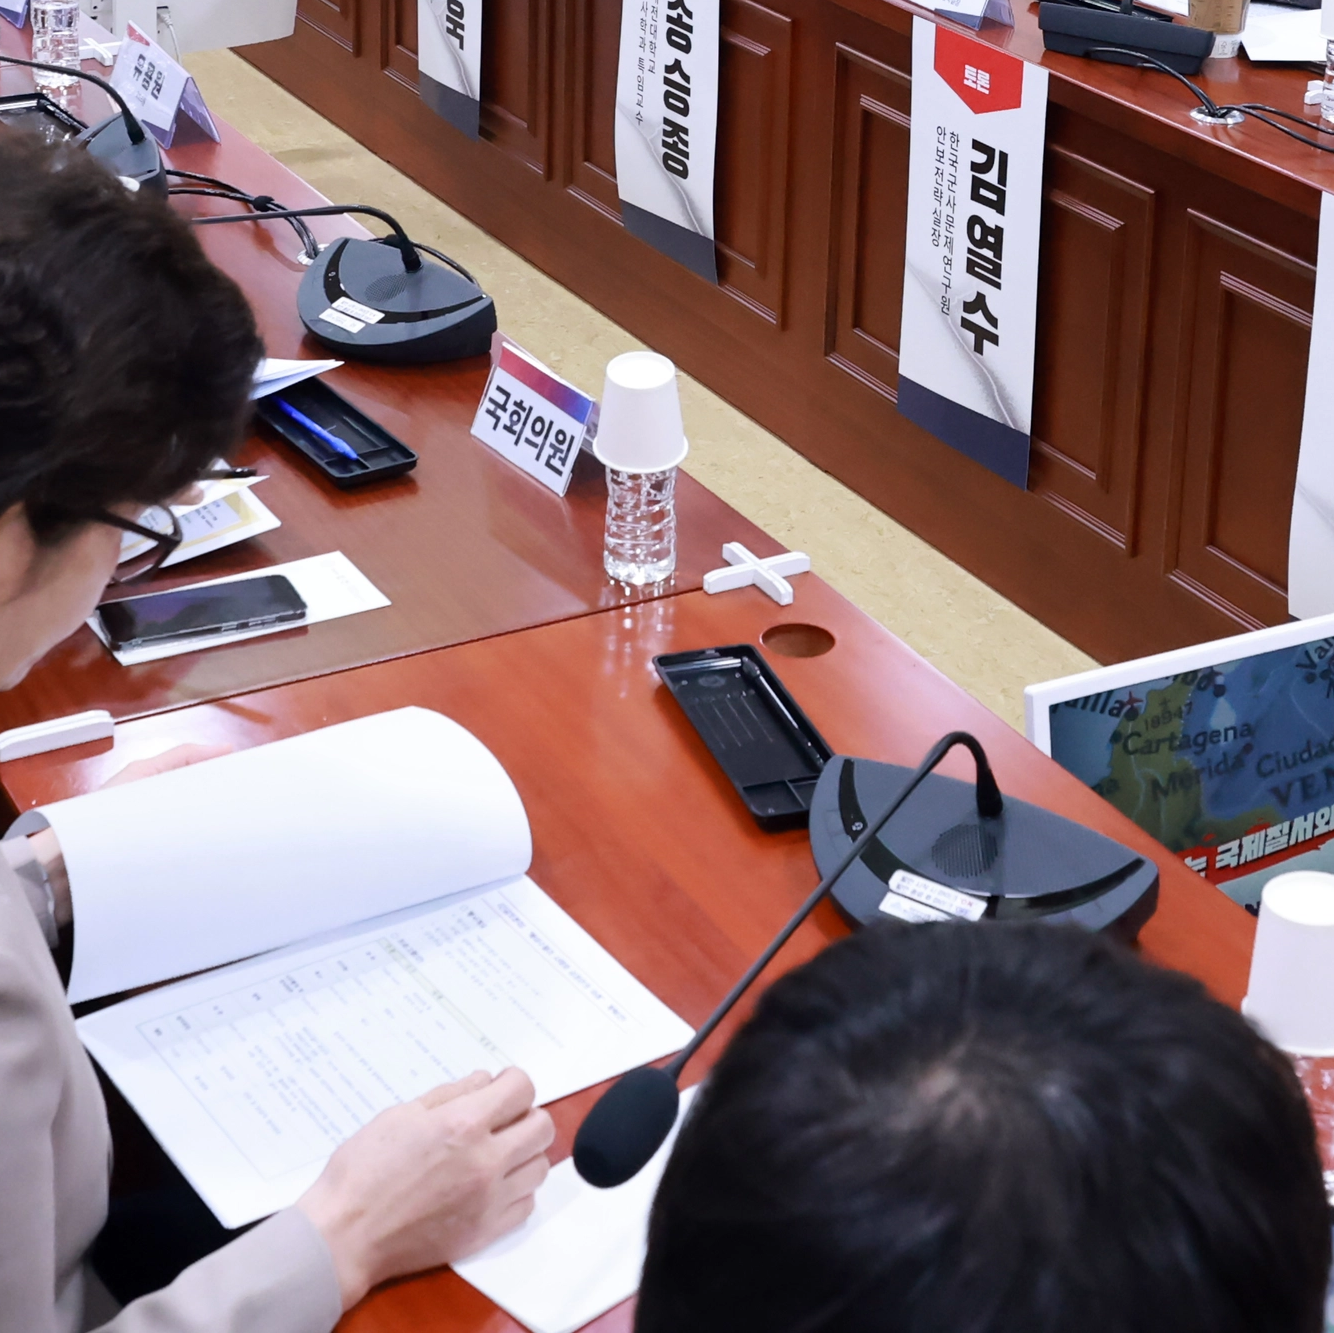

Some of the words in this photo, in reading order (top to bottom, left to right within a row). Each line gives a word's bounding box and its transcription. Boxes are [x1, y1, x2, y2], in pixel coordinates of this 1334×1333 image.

[635, 56, 645, 127] 특임교수
[963, 64, 990, 95] 토론
[930, 125, 947, 248] 안보전략실장
[939, 130, 960, 316] 한국군사문제연구원
[960, 138, 1009, 356] 김열수
[485, 385, 575, 477] 국회의원
[1122, 722, 1255, 756] Cartagena
